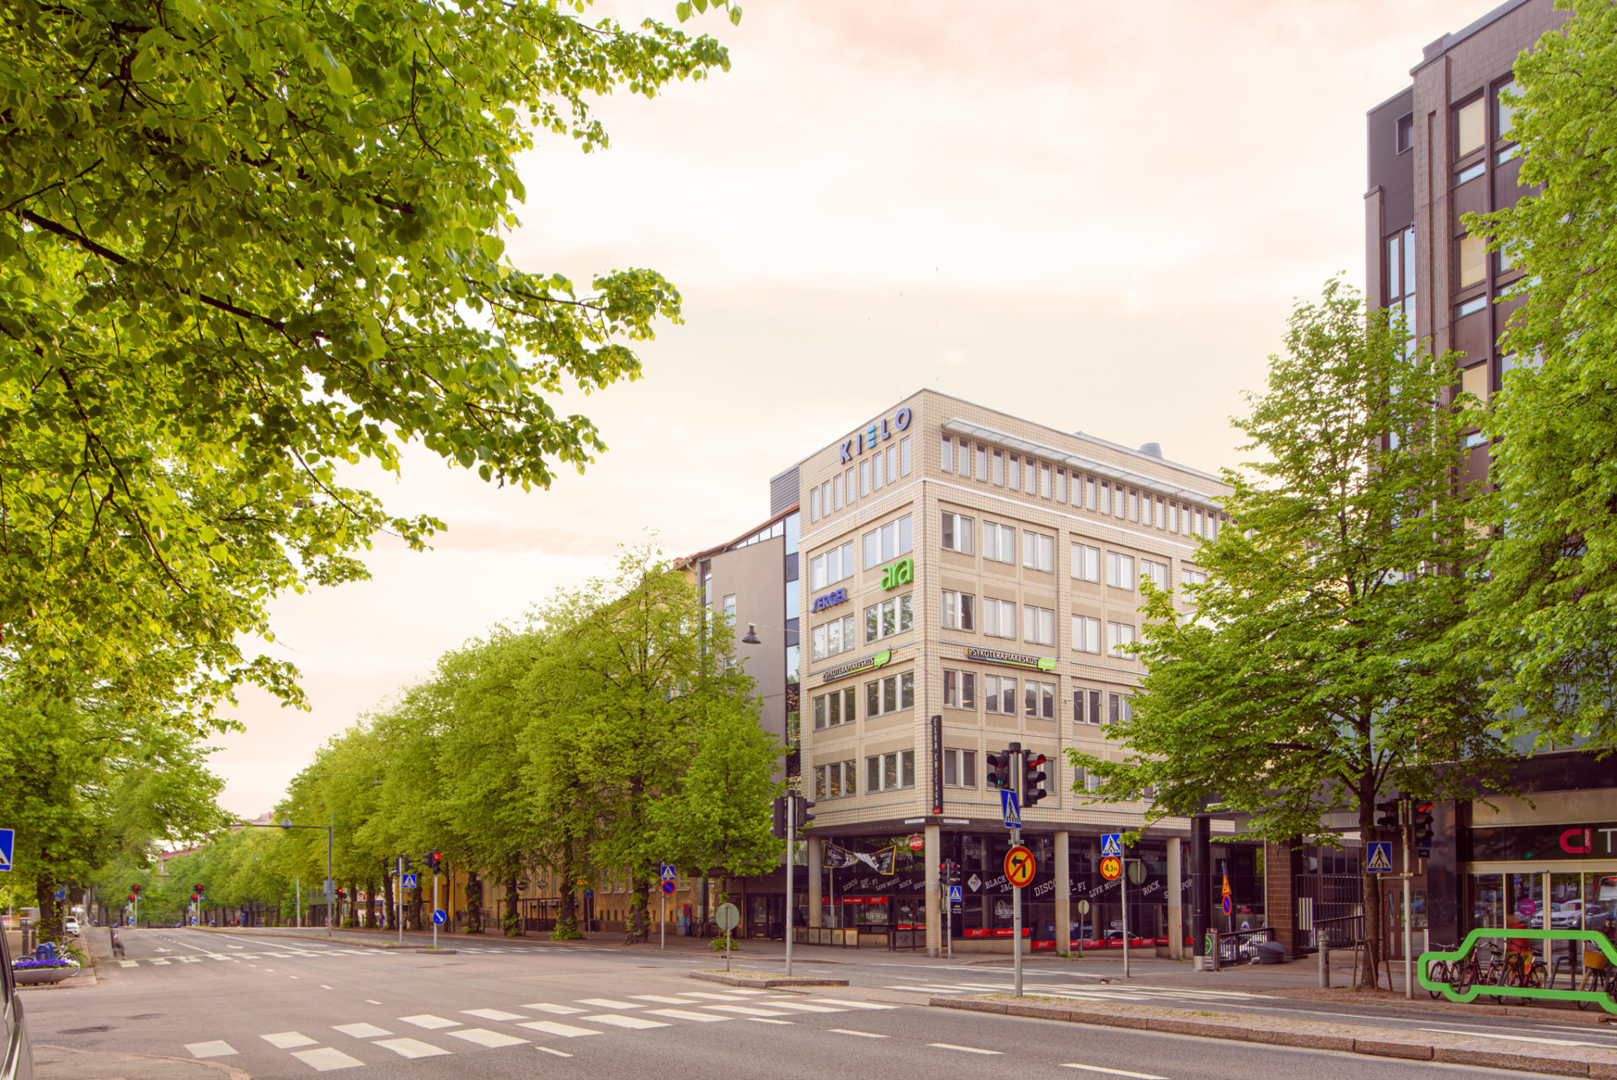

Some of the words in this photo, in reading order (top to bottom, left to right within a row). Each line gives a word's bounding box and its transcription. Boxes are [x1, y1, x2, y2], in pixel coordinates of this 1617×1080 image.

[839, 407, 912, 464] KIELO
[880, 558, 913, 591] ara
[811, 587, 849, 613] SERGEL
[985, 875, 1007, 889] BLACK
[1000, 882, 1013, 893] JAC
[1088, 885, 1104, 898] LIVE
[1142, 880, 1161, 896] ROCK
